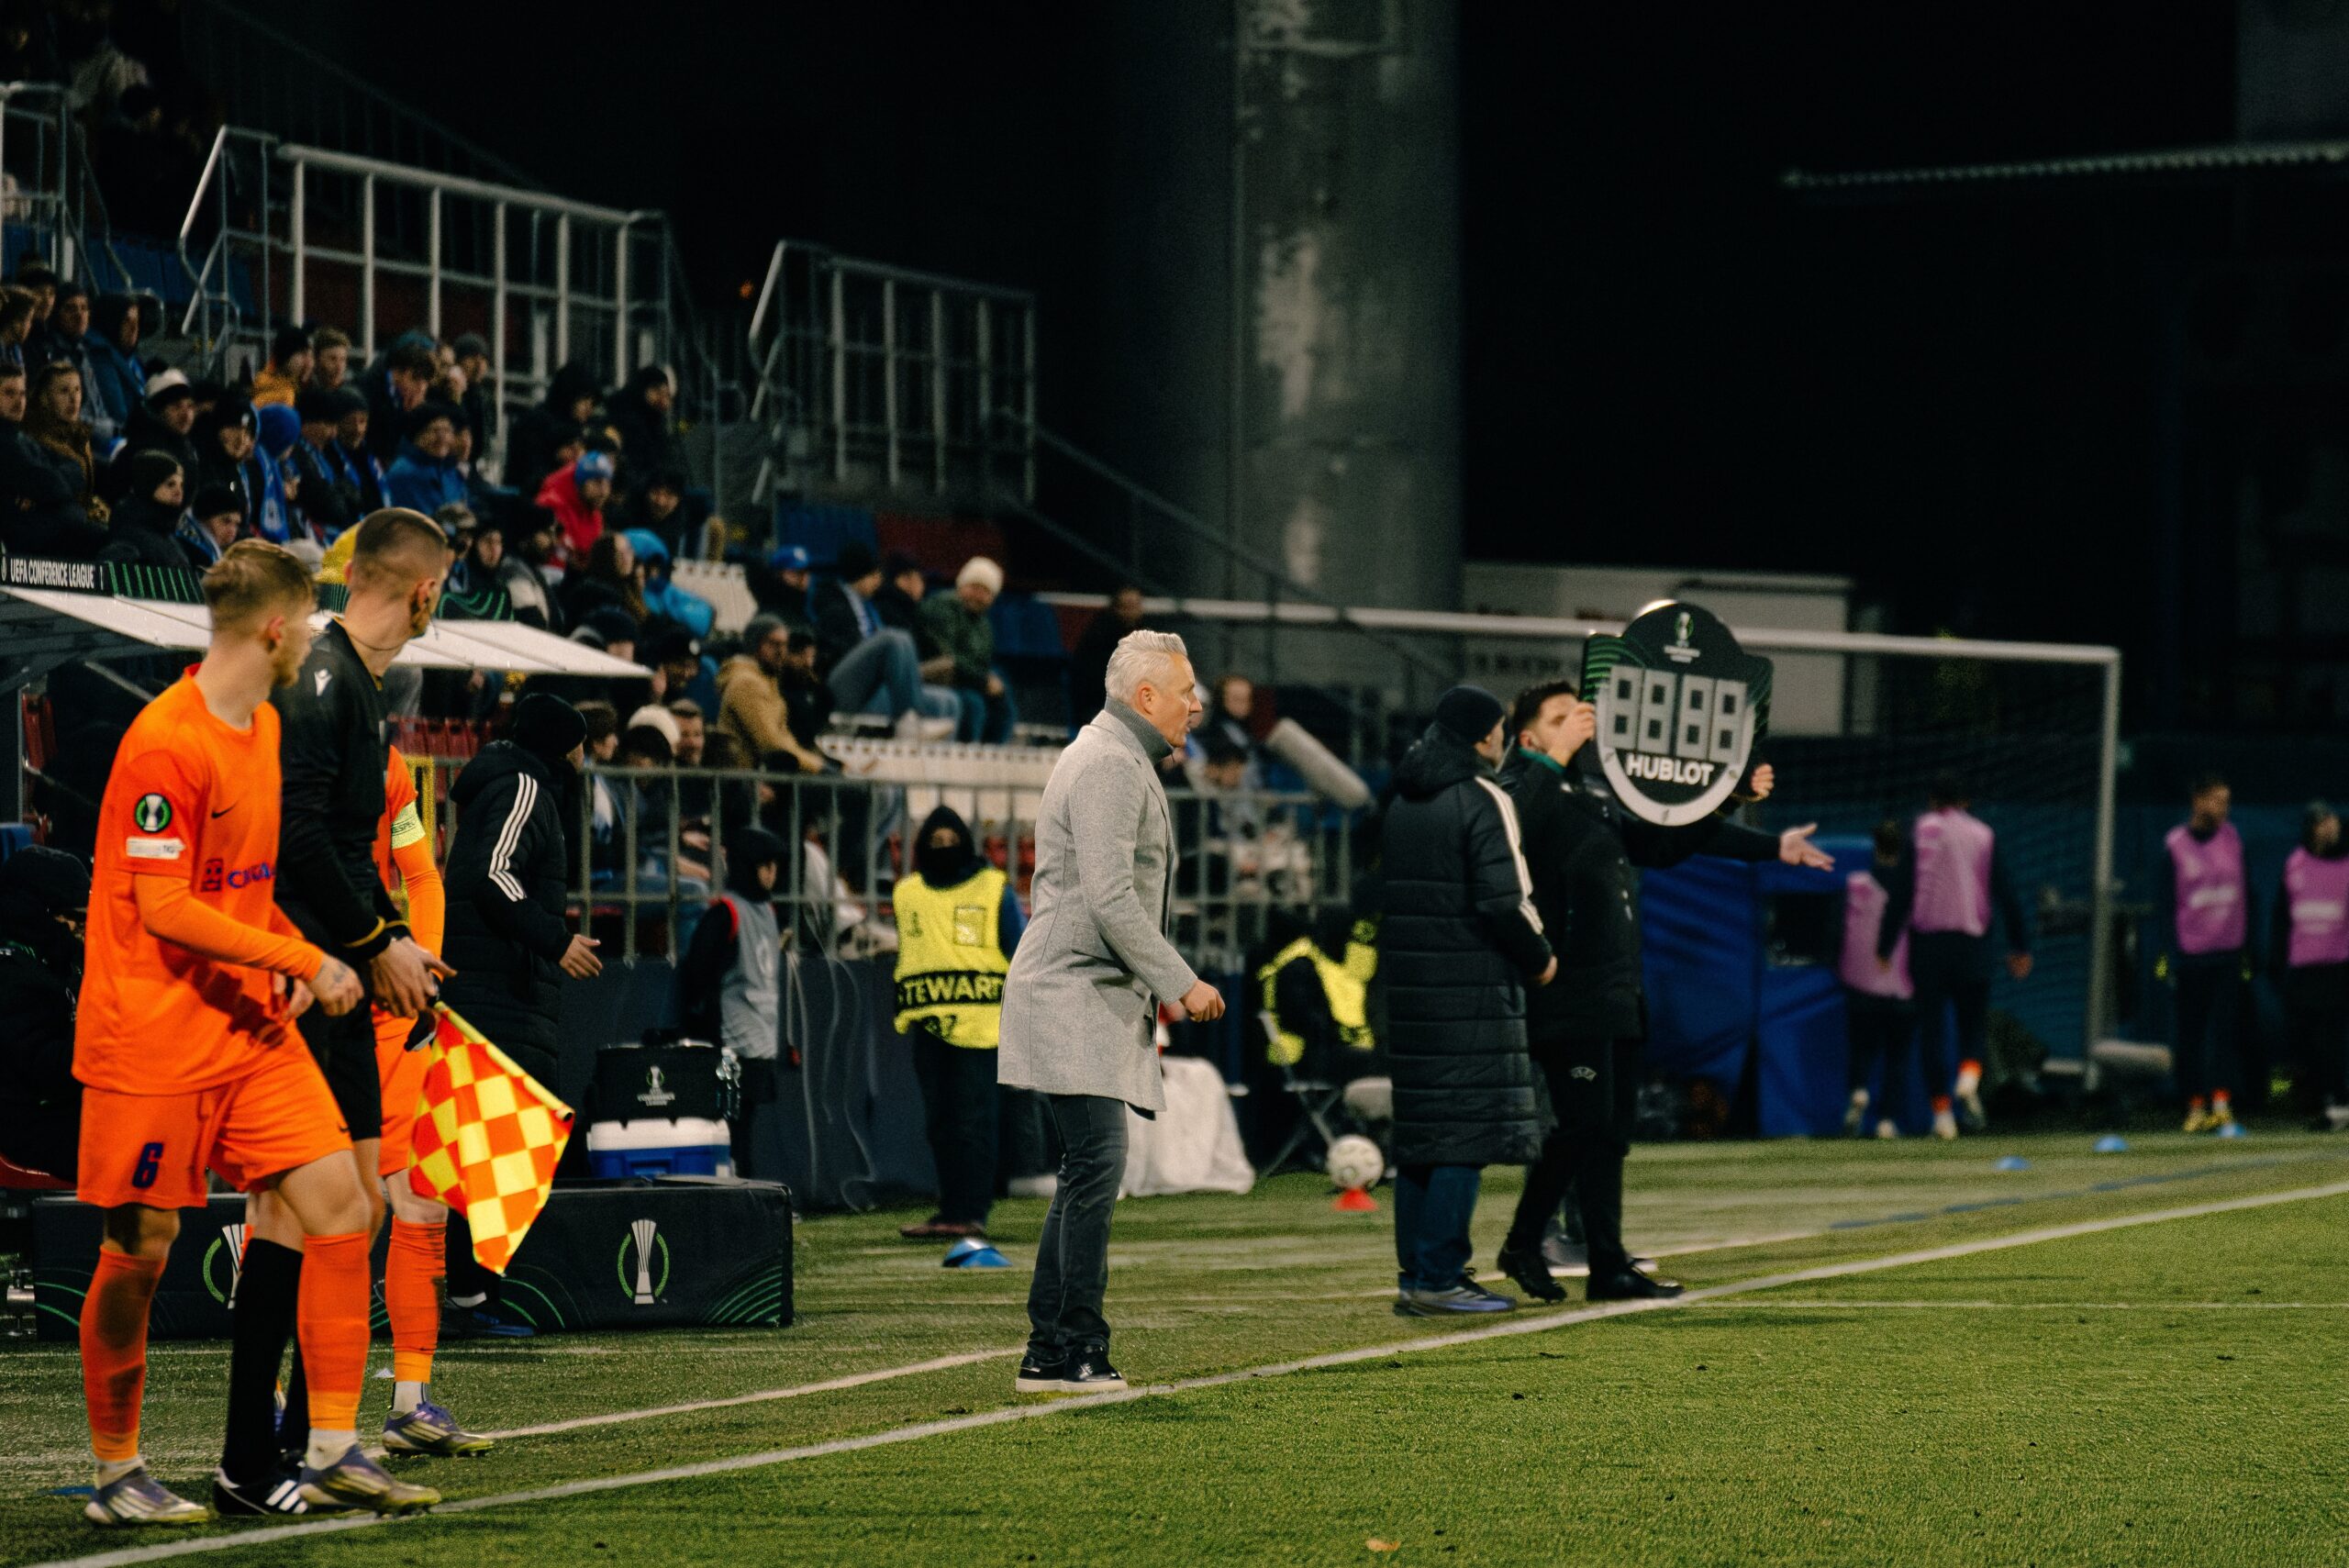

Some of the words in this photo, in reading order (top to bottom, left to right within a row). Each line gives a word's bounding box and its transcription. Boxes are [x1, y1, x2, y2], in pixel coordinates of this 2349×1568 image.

[10, 557, 28, 584] UEFA
[28, 558, 68, 587] CONFERENCE
[69, 562, 95, 589] LEAGUE
[1625, 752, 1715, 787] HUBLOT
[131, 1140, 164, 1190] 6
